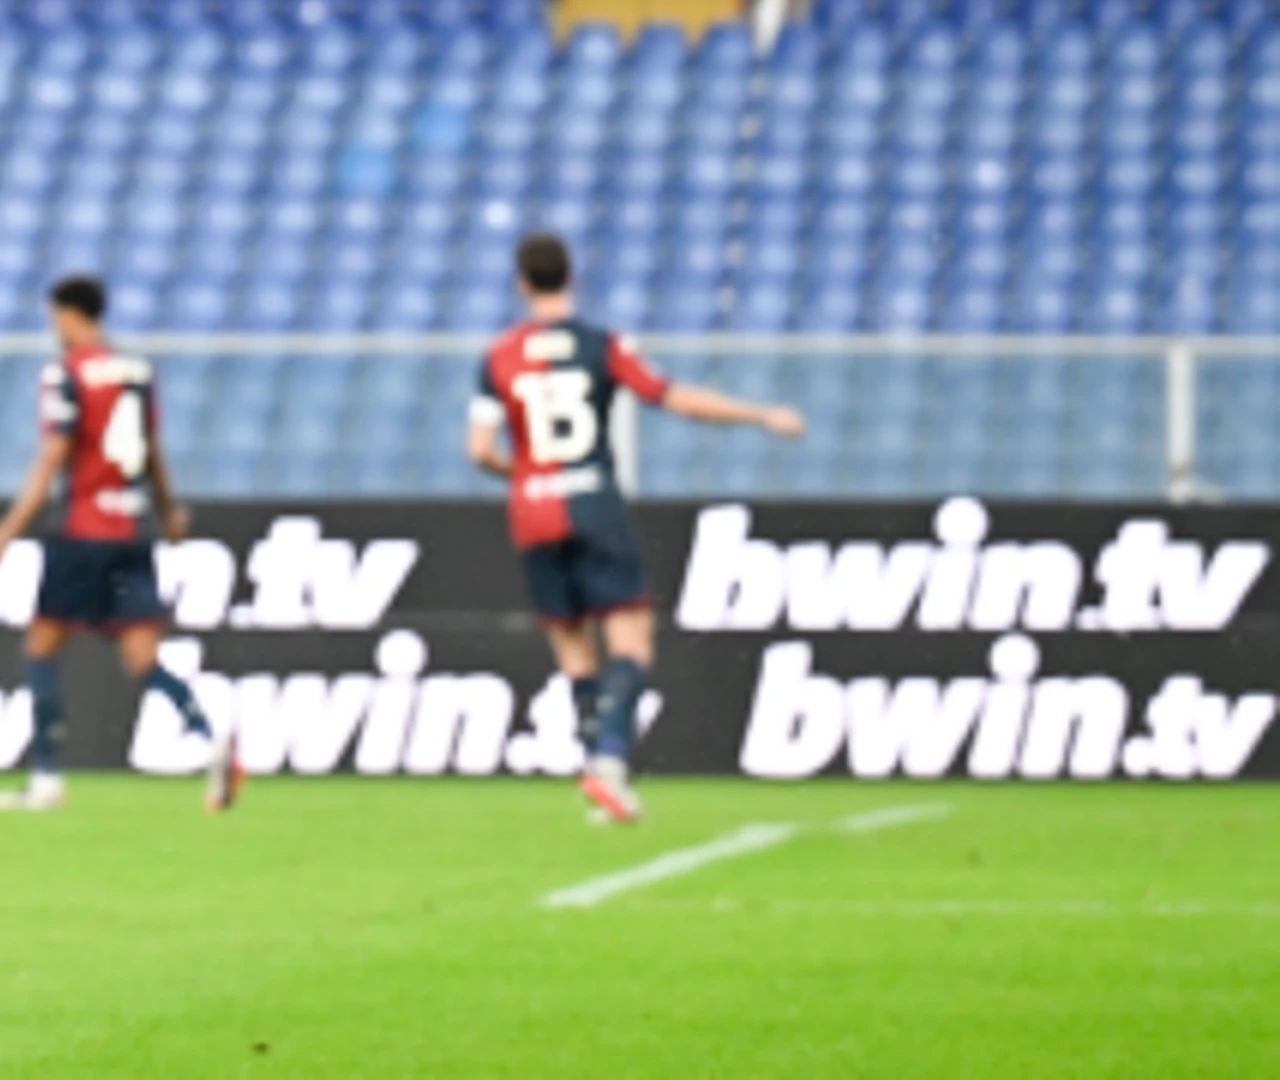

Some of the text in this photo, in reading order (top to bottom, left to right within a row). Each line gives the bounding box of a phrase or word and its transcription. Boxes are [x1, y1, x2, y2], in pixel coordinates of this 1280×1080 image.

[101, 389, 148, 478] 4
[676, 497, 1270, 633] bwin.tv
[740, 634, 1276, 779] bwin.tv
